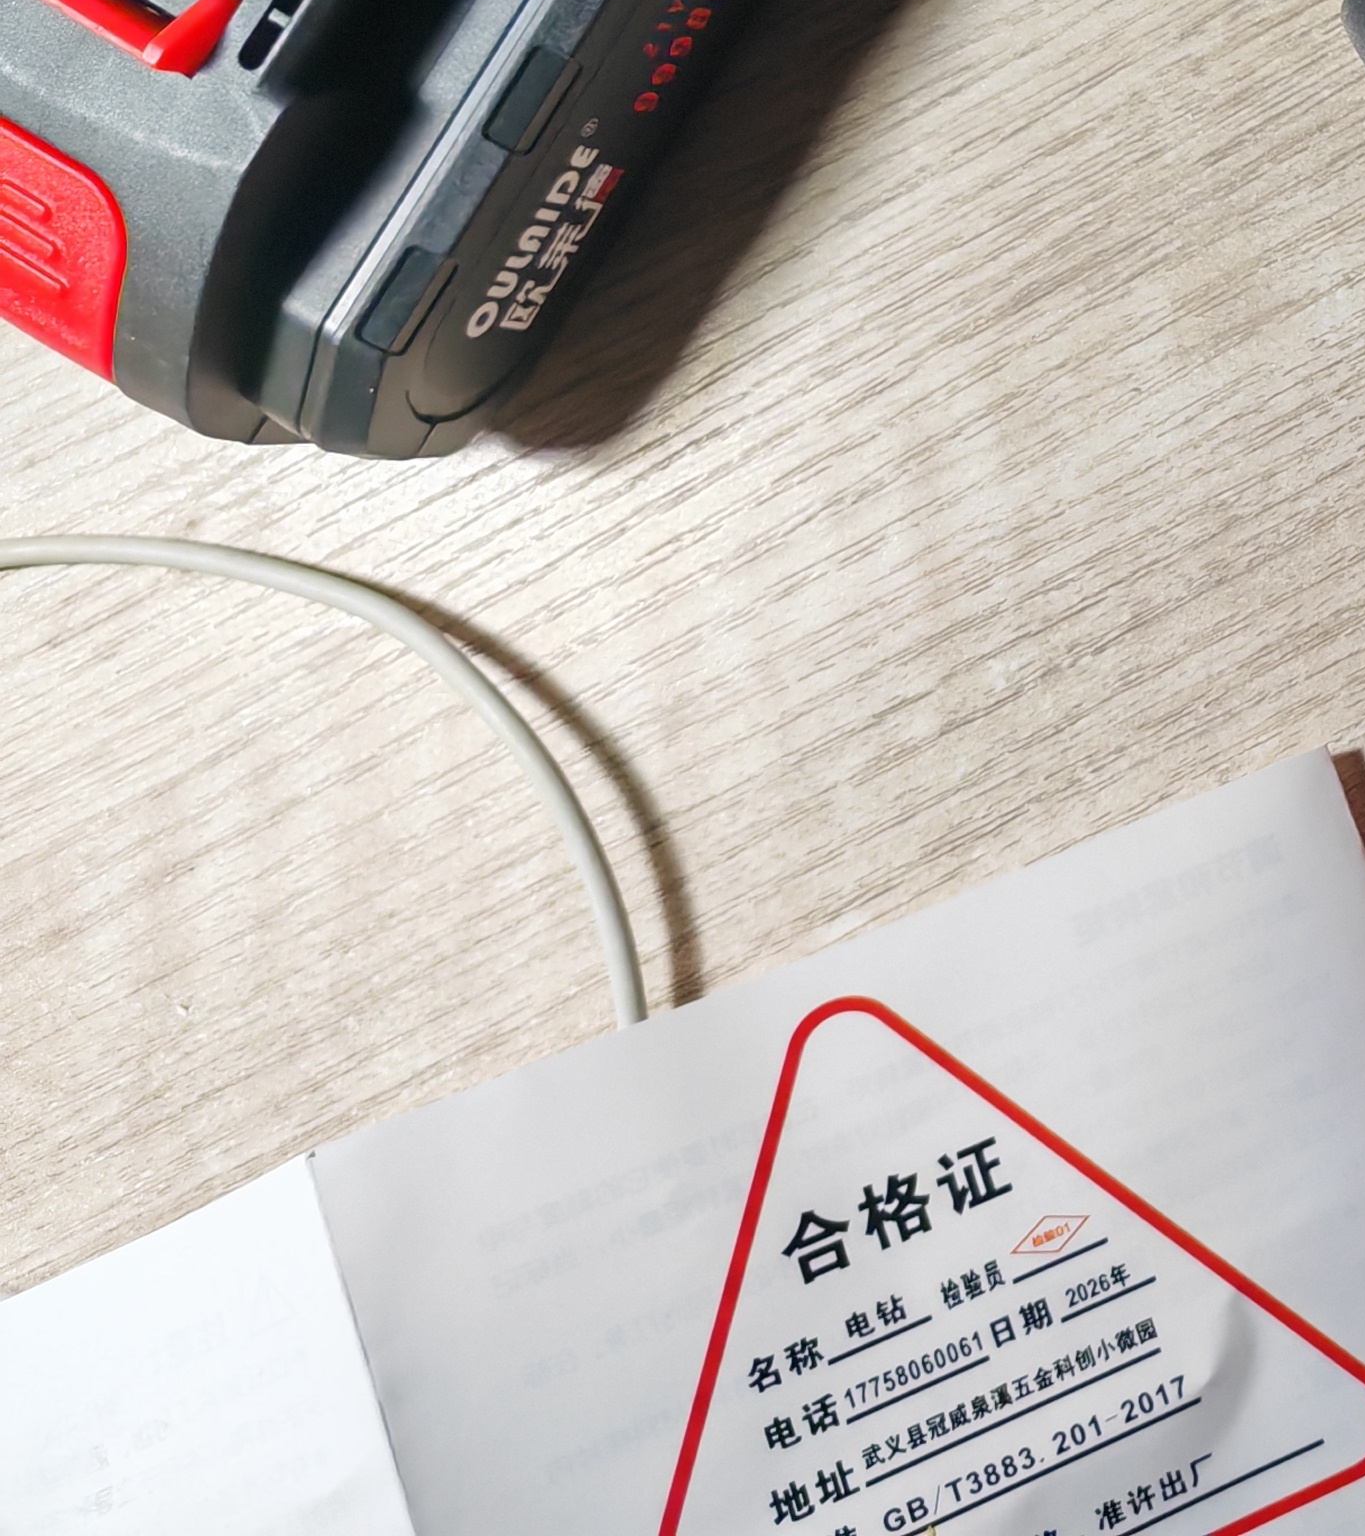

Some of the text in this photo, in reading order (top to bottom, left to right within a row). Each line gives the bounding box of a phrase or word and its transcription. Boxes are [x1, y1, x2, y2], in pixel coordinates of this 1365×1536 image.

[499, 164, 622, 330] 欧莱德
[782, 1137, 1012, 1284] 合格证
[748, 1338, 831, 1393] 名称
[845, 1295, 906, 1337] 电钻
[941, 1260, 1005, 1310] 检验员
[764, 1264, 1130, 1449] 电话 17758060061 日期 2026年
[770, 1461, 860, 1525] 地址
[1095, 1453, 1211, 1530] 准许出厂
